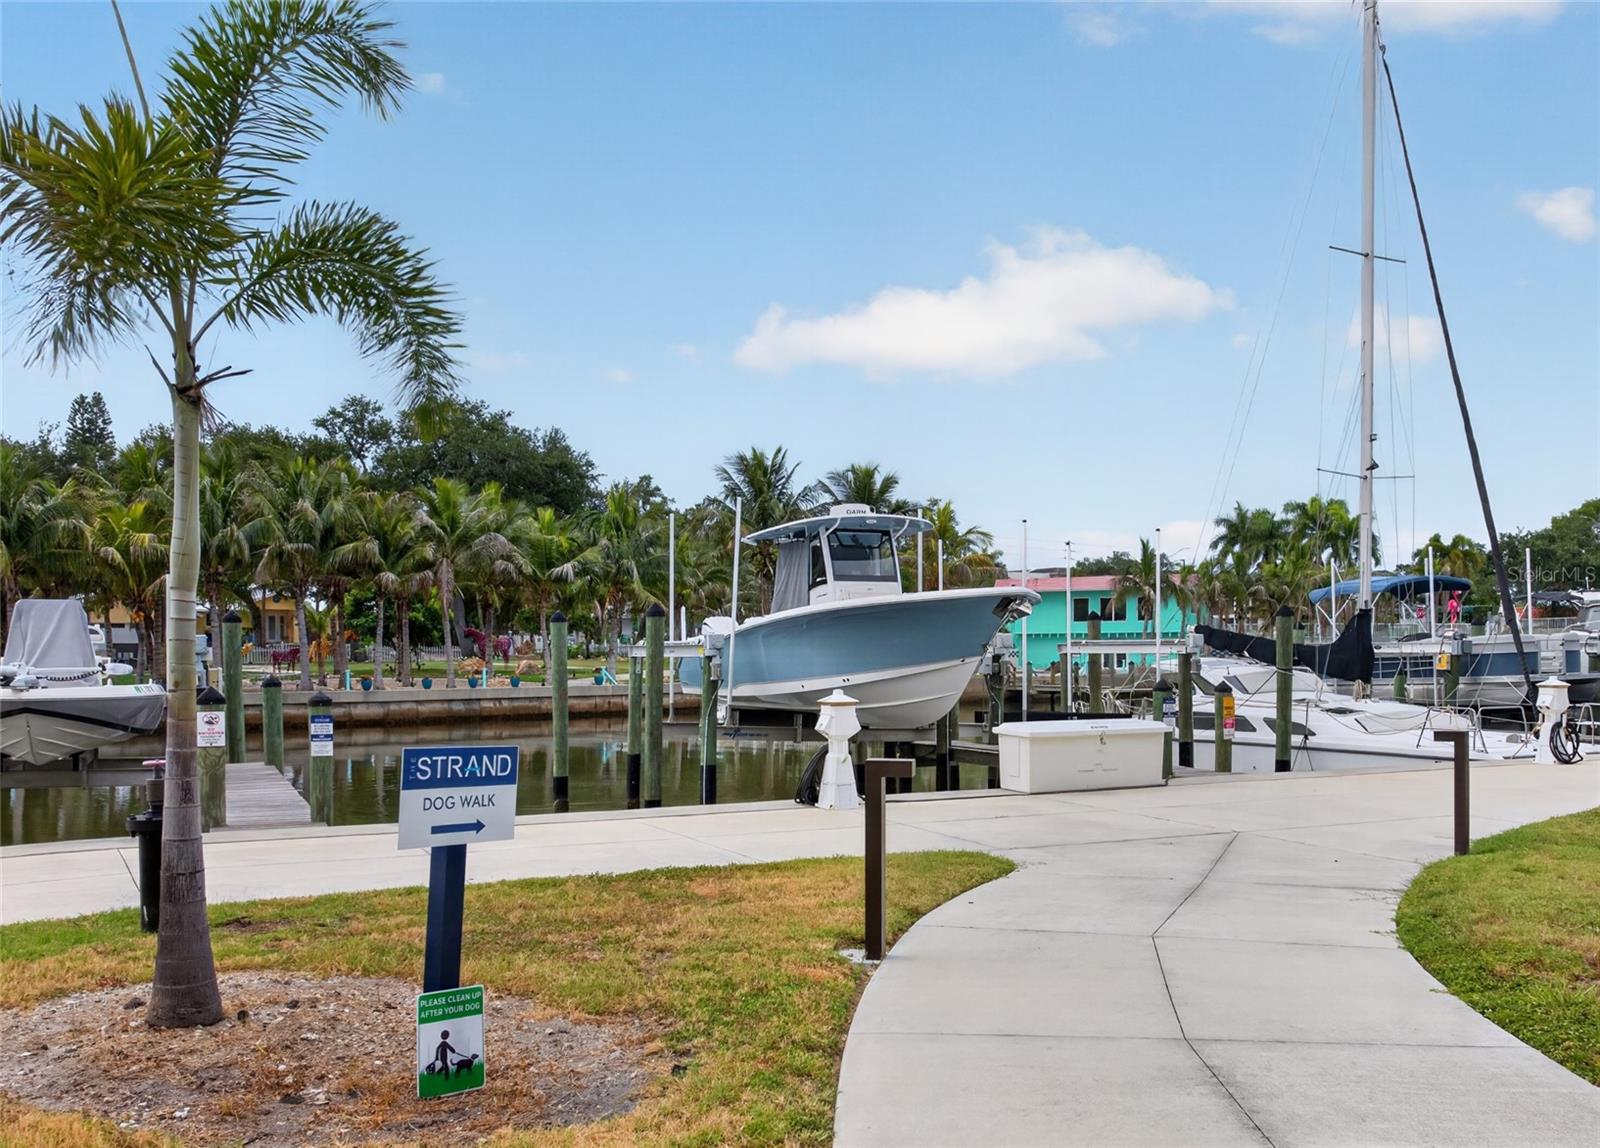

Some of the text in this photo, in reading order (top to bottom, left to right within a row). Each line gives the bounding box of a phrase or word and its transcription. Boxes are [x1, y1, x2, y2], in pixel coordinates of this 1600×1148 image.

[416, 755, 511, 780] STRAND
[423, 794, 496, 811] DOG WALK
[420, 991, 482, 1007] PLEASE CLEAN UP
[421, 1002, 480, 1018] AFTER YOUR DOG
